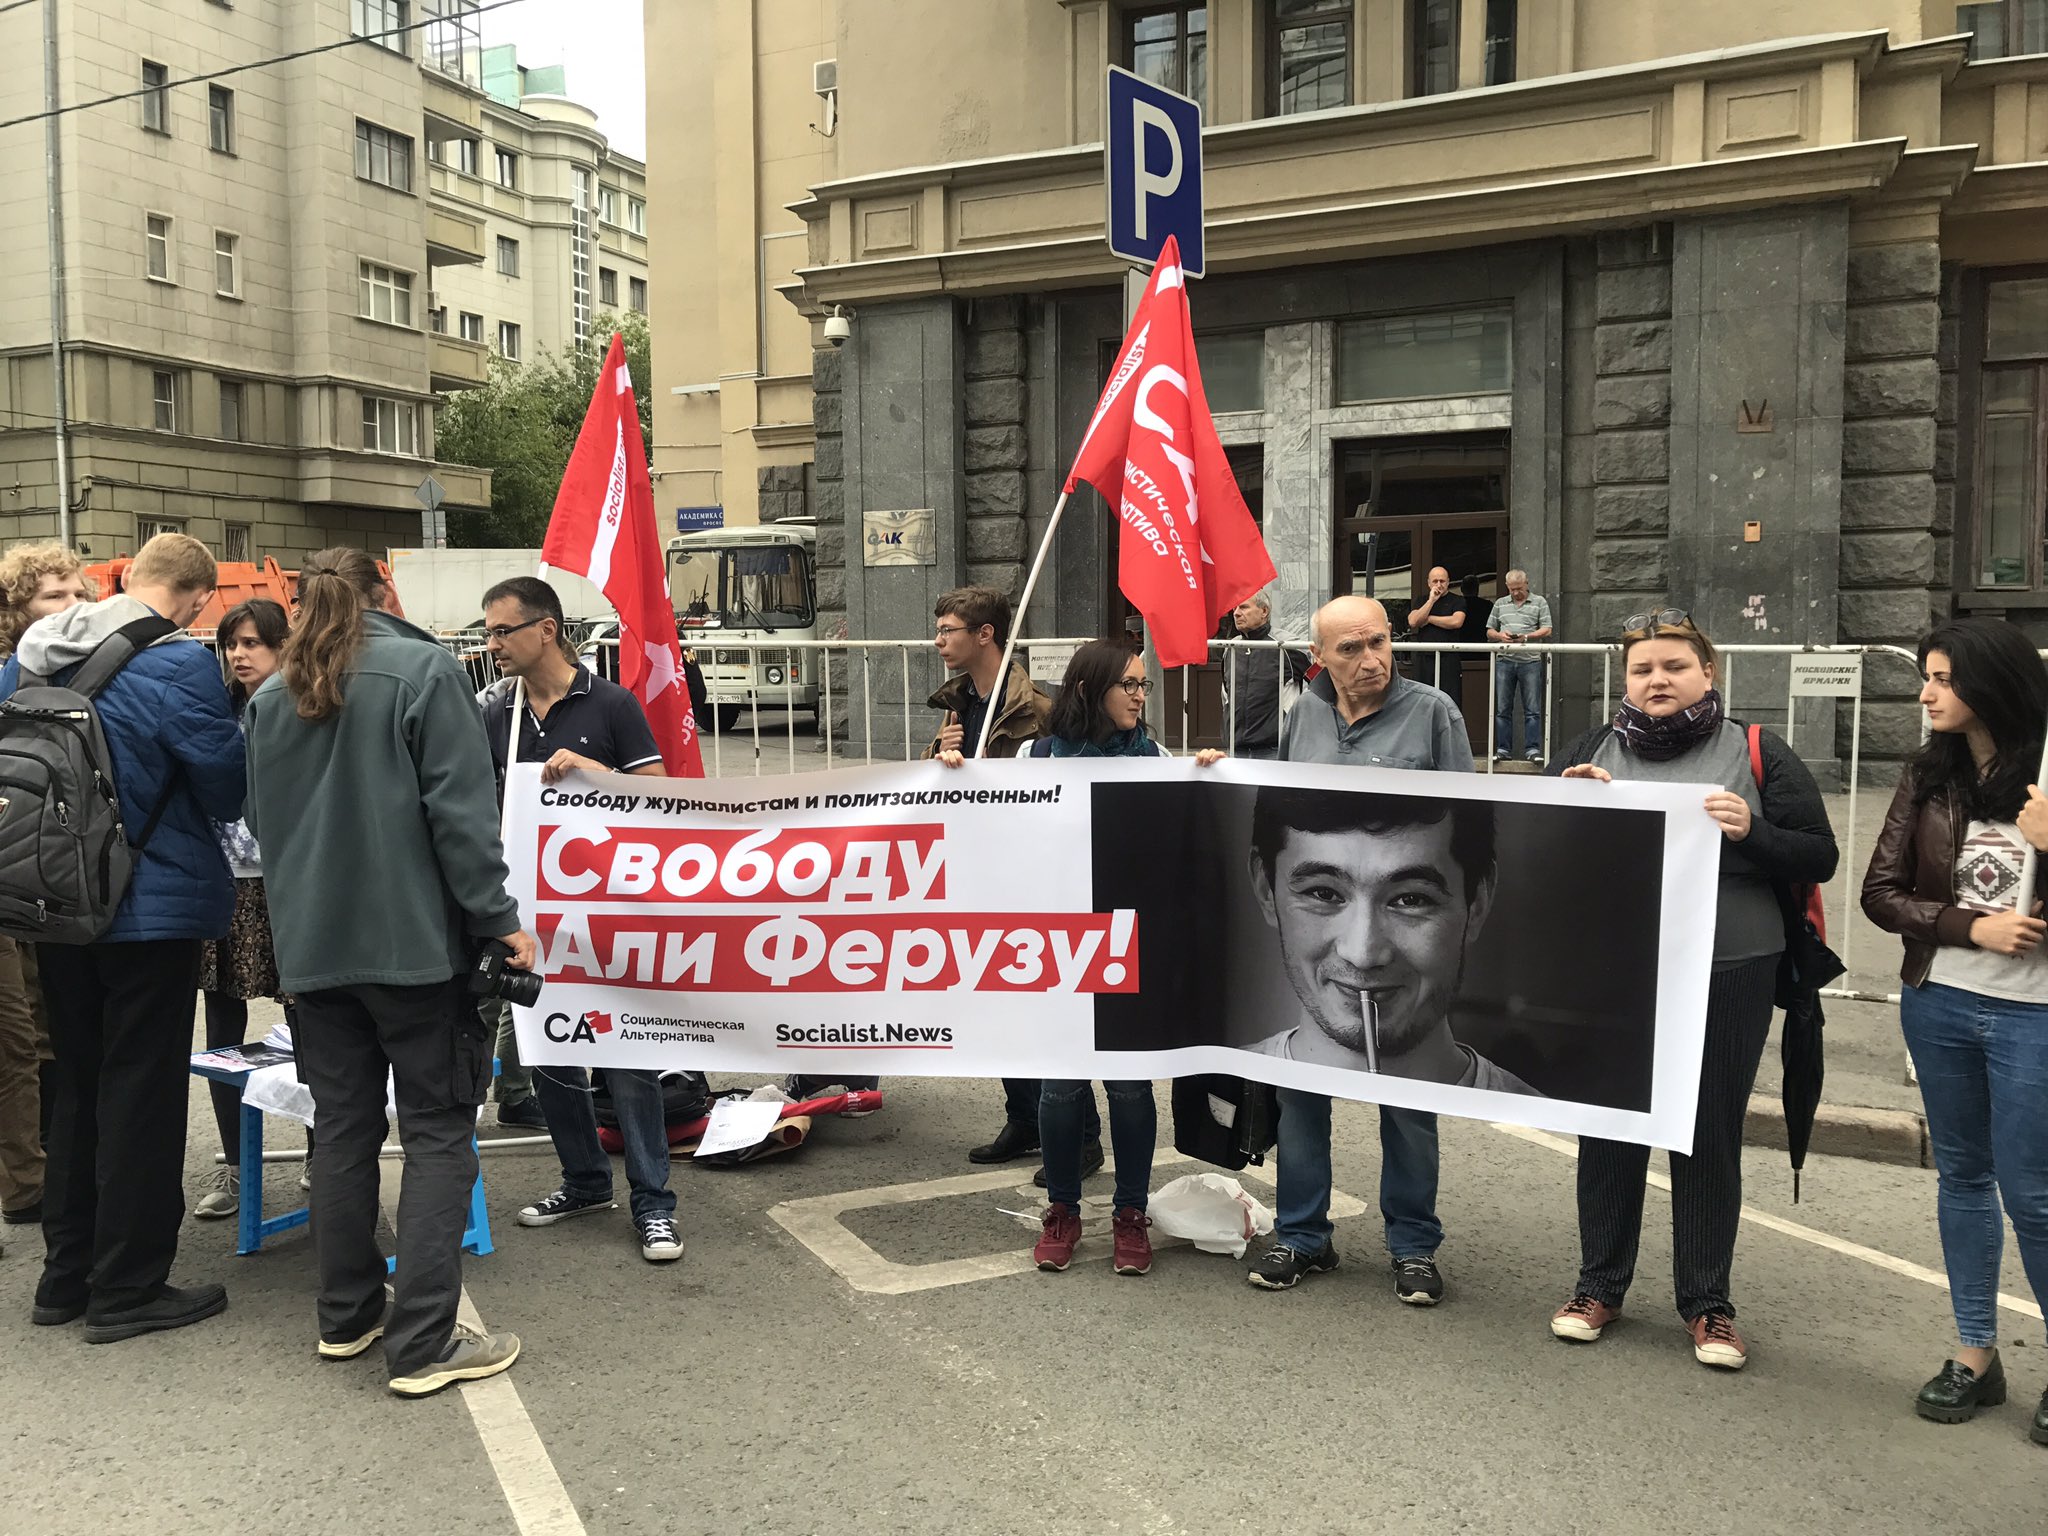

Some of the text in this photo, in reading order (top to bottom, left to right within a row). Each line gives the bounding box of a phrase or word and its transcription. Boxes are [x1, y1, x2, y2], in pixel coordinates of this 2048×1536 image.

[1133, 98, 1183, 240] P
[680, 512, 718, 520] АКАДЕМИКА
[1794, 666, 1858, 674] МОСКОВСКИЕ
[1802, 677, 1851, 685] ЯРМАРКИ
[540, 784, 1062, 815] Свободу журналистам и политзаключенным!
[541, 821, 946, 903] Свободу
[543, 908, 1136, 994] Али Ферузу!
[620, 1013, 745, 1031] Социалистическая
[620, 1028, 715, 1044] Альтернатива
[776, 1023, 953, 1043] Socialist.News
